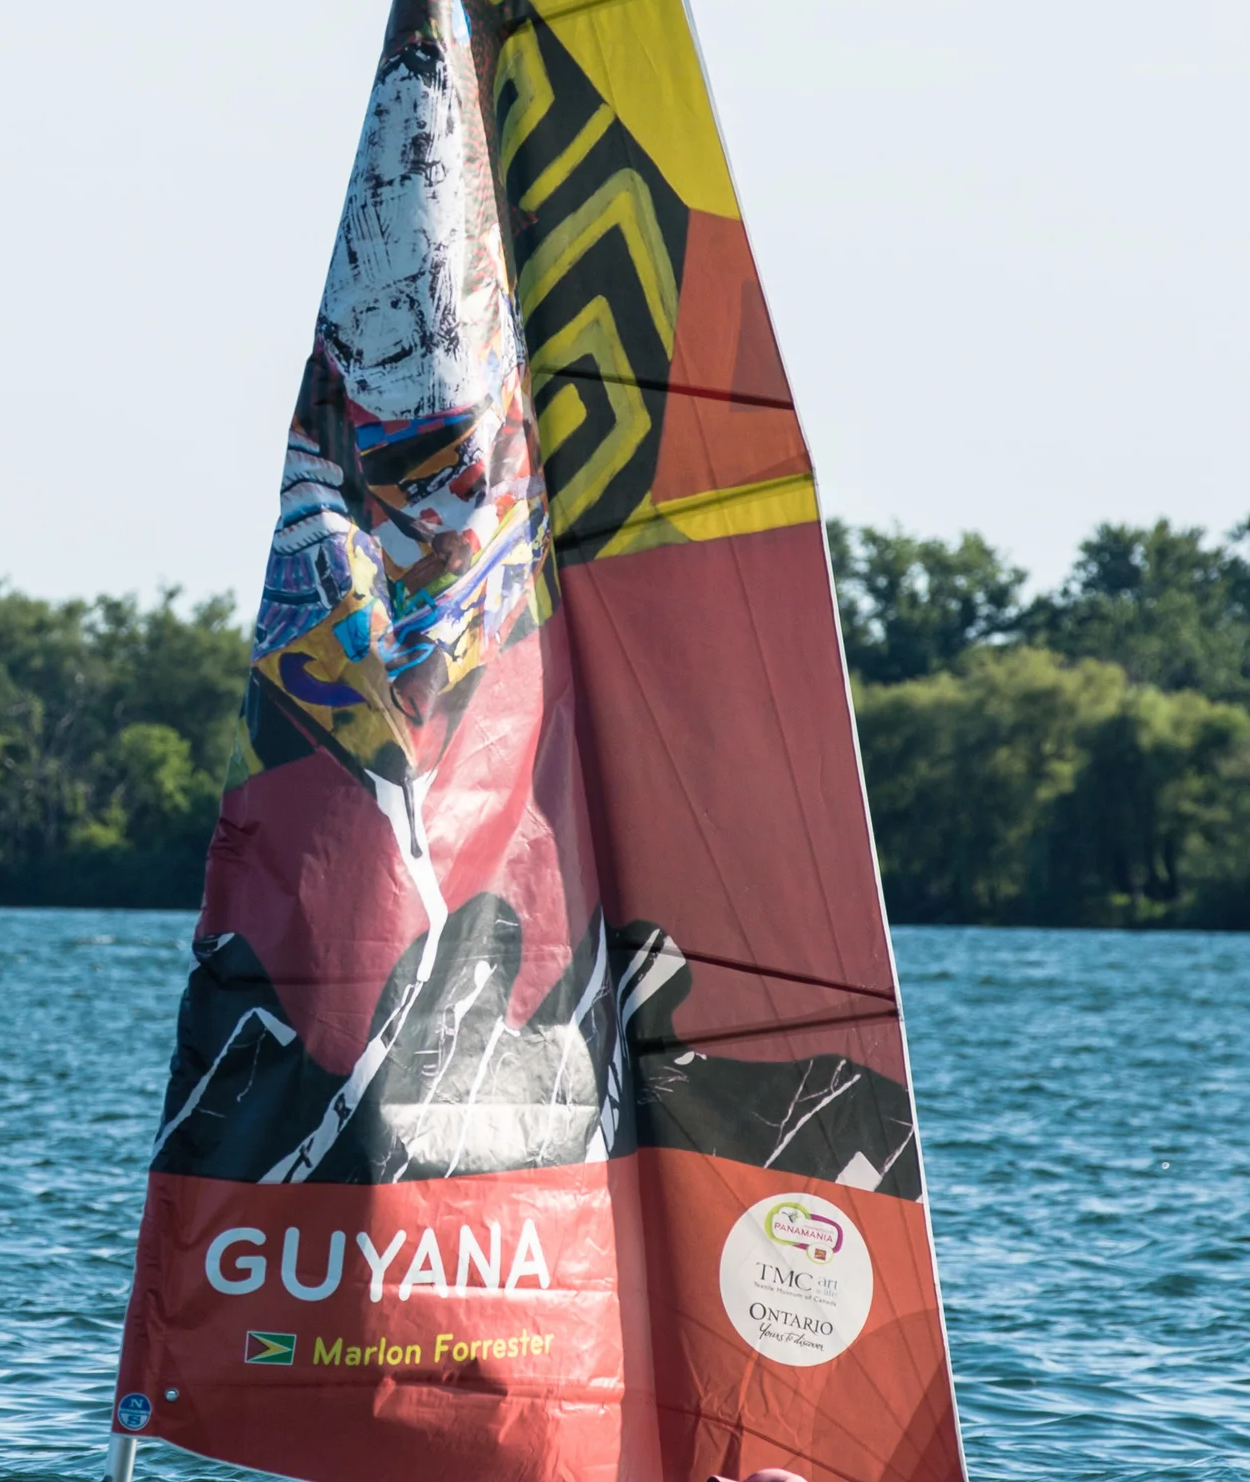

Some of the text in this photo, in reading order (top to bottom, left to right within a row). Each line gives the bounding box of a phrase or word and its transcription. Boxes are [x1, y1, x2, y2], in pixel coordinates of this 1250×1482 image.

[774, 1222, 834, 1243] PANAMANIA
[204, 1218, 551, 1303] GUYANA
[755, 1261, 839, 1291] TMC art
[754, 1281, 775, 1292] Textile
[776, 1287, 803, 1299] Museum
[804, 1293, 813, 1301] of
[813, 1295, 838, 1307] Canada
[749, 1302, 834, 1336] ONTARIO
[312, 1328, 555, 1366] Marlon Forrester
[759, 1322, 784, 1341] Yours
[793, 1333, 825, 1352] discover
[130, 1398, 143, 1409] N
[127, 1415, 141, 1425] S
